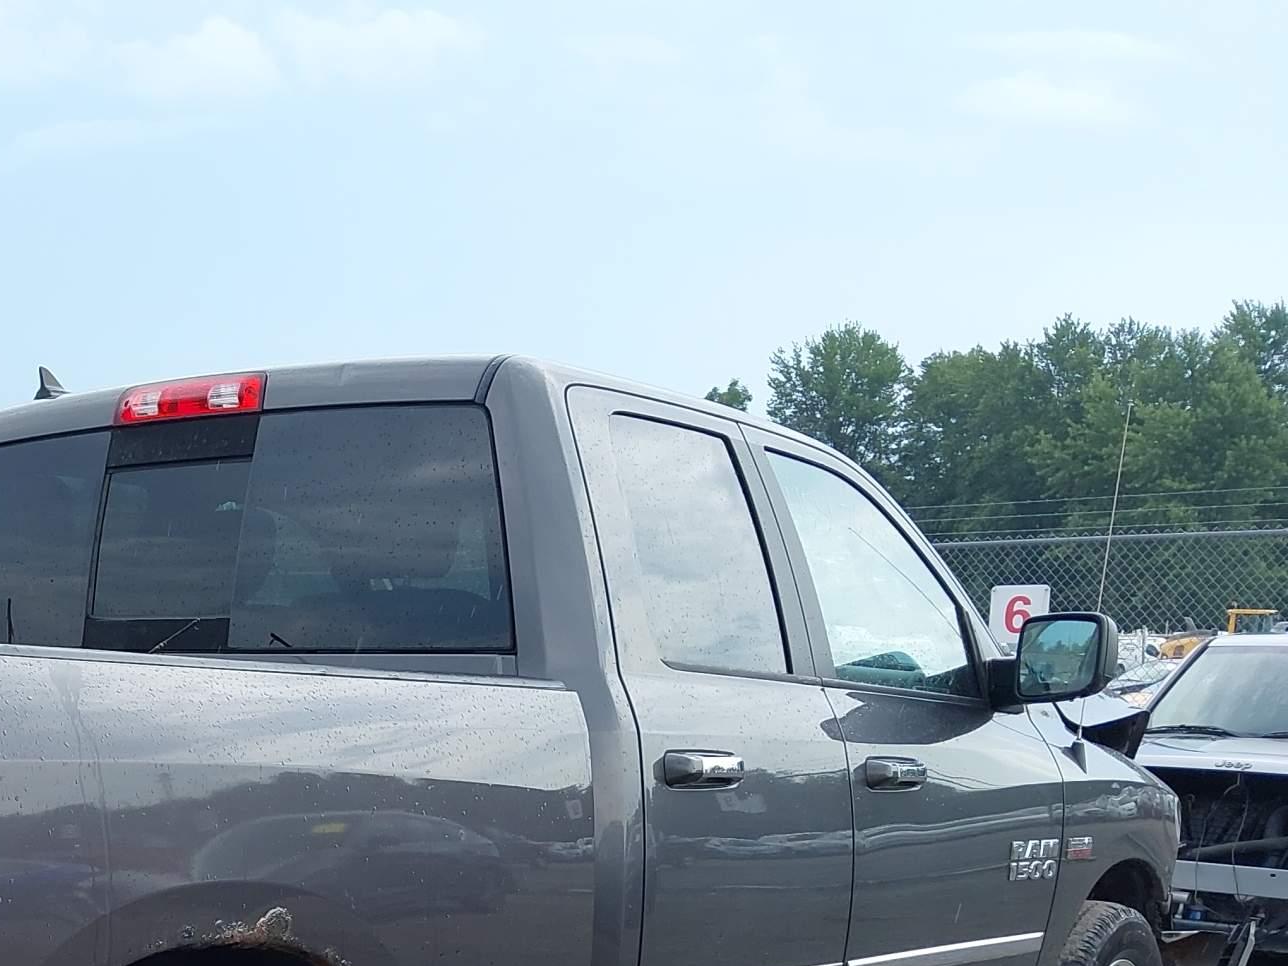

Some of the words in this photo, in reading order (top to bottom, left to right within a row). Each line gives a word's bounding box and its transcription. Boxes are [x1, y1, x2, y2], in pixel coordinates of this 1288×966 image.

[1004, 595, 1033, 634] 6
[1214, 759, 1254, 771] Jeep
[1011, 838, 1060, 860] RAM
[1009, 859, 1058, 881] 1500
